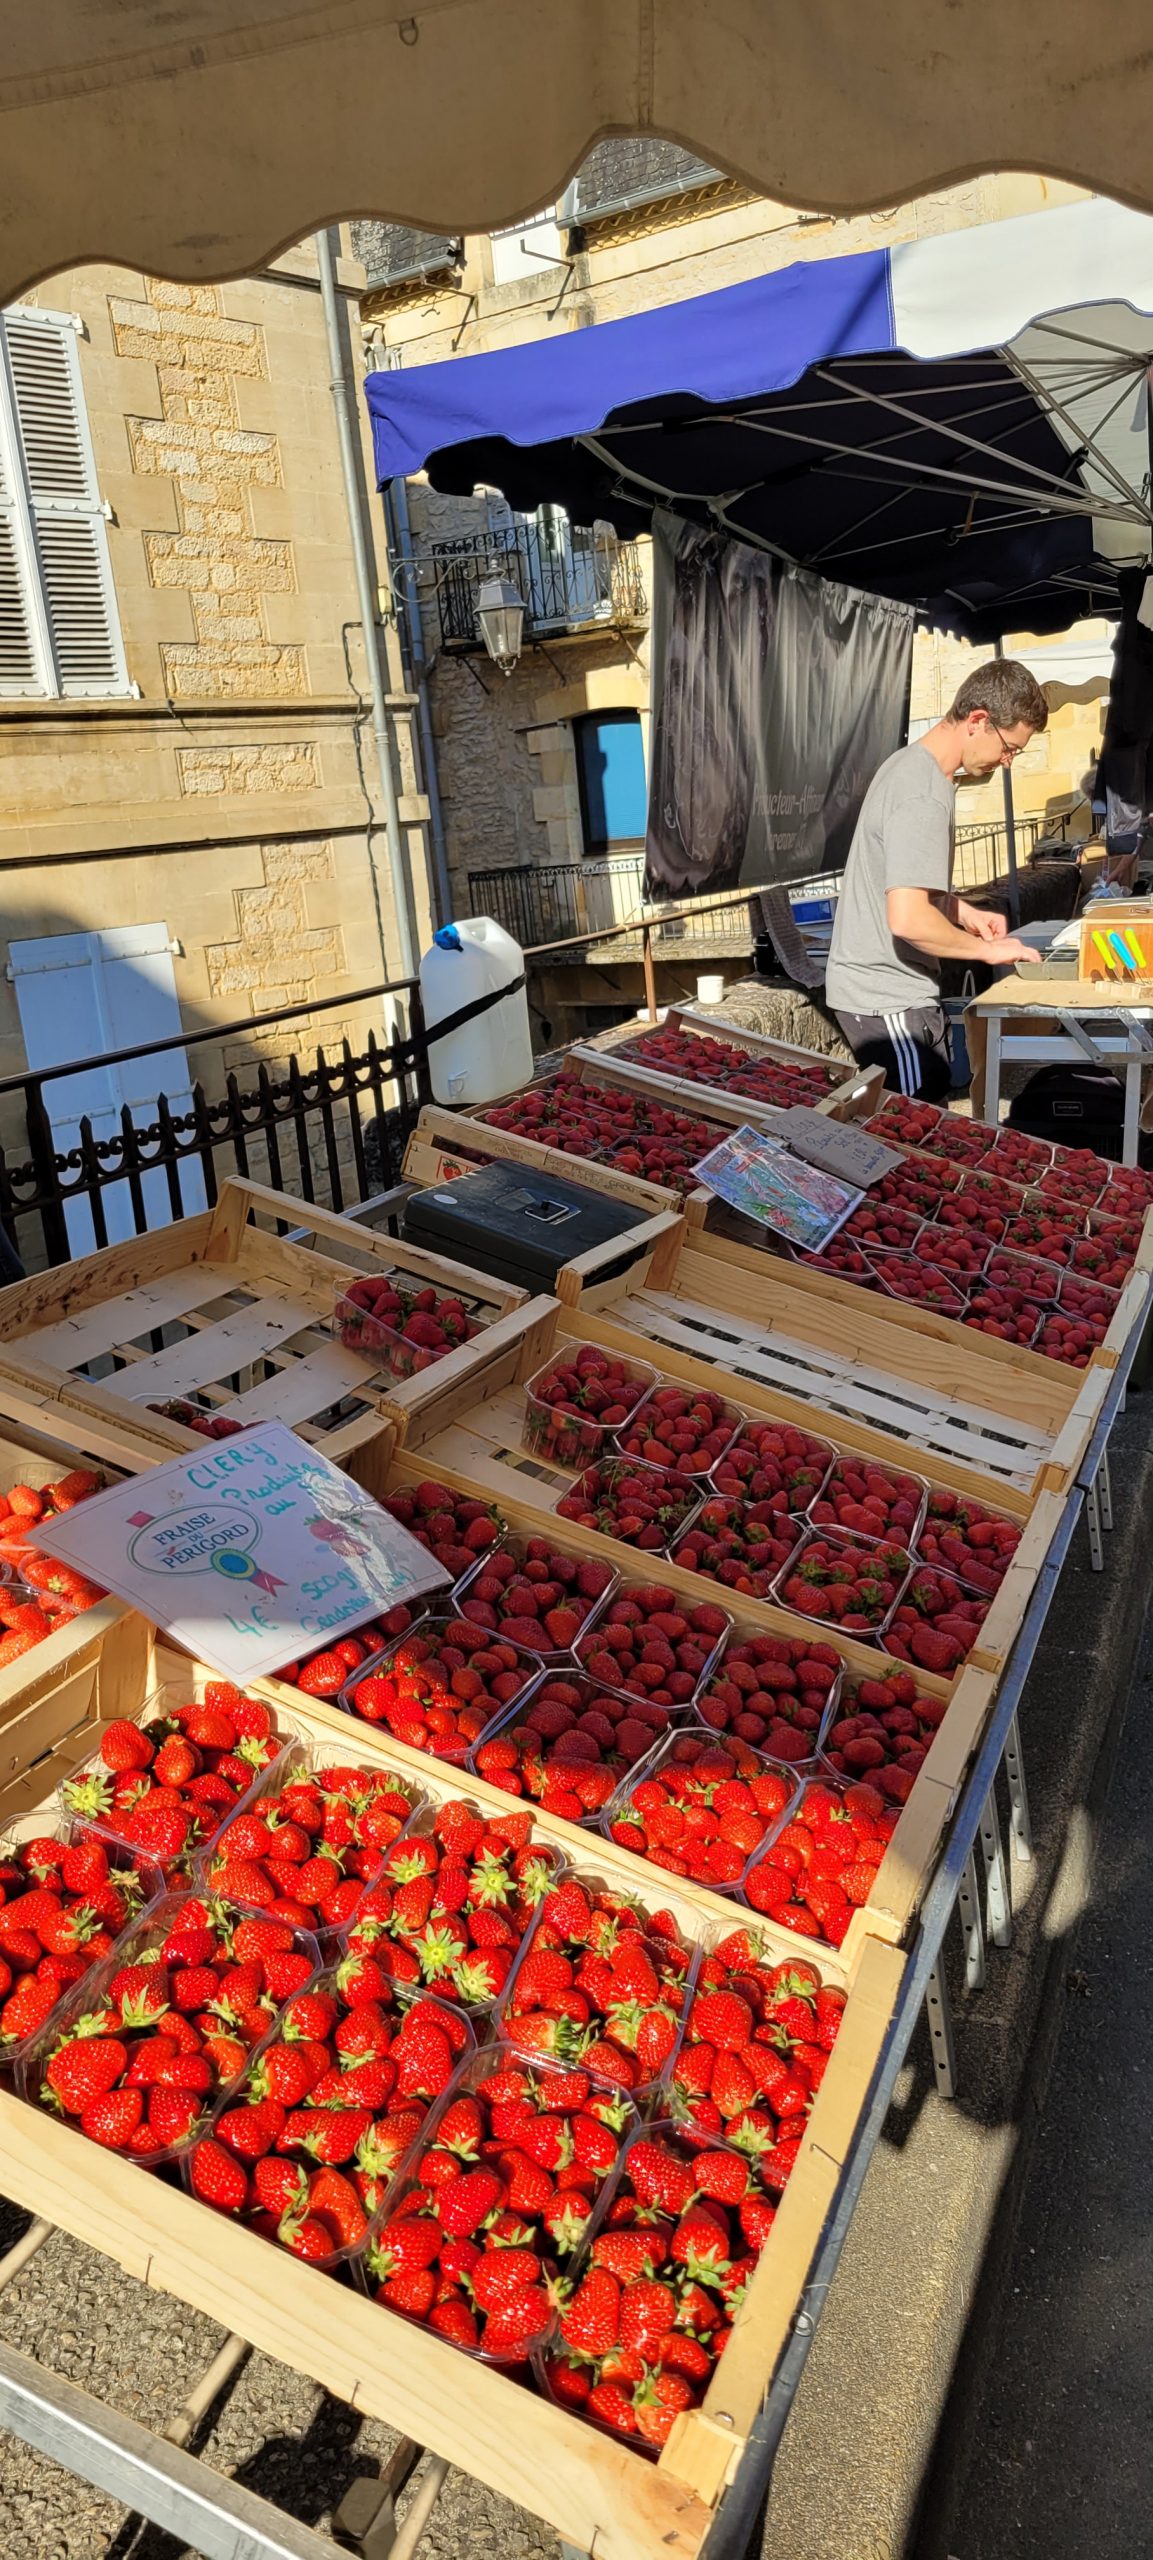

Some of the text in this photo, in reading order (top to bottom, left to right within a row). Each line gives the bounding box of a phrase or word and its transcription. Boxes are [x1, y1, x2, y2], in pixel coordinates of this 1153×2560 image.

[265, 1499, 297, 1515] au
[153, 1512, 216, 1545] FRAISE
[187, 1532, 204, 1543] DU
[161, 1523, 249, 1569] PÉRIGORD
[223, 1605, 279, 1637] 4€
